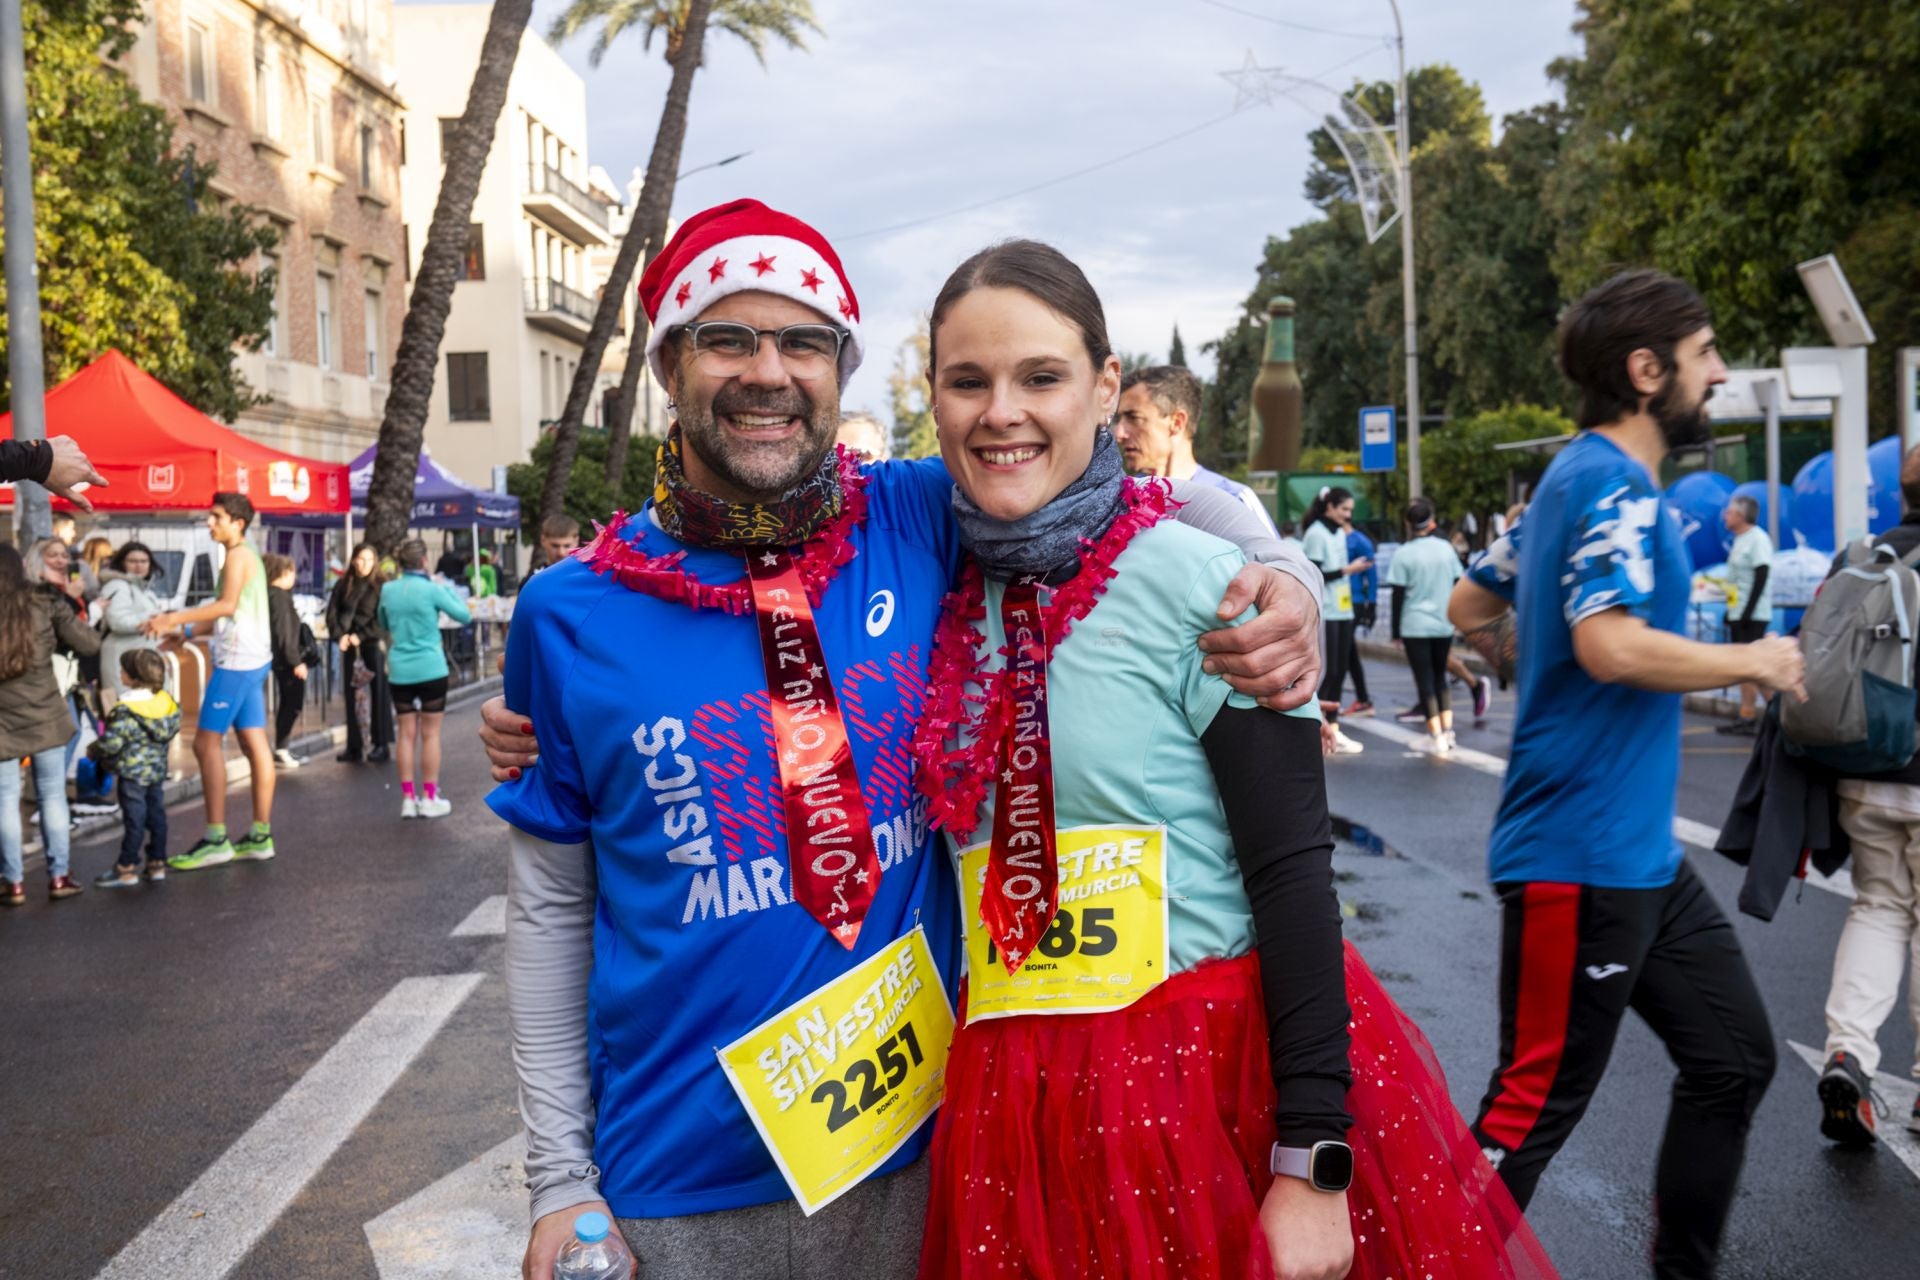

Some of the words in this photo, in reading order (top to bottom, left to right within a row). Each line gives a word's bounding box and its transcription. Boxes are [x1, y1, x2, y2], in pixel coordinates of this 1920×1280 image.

[767, 588, 807, 669] FELIZ
[1011, 609, 1036, 689] FELIZ
[783, 679, 828, 751] AÑO
[1012, 701, 1042, 771] AÑO
[632, 715, 718, 866] ASICS
[798, 760, 858, 877] NUEVO
[1001, 783, 1042, 901] NUEVO
[1058, 871, 1142, 904] MURCIA
[987, 908, 1118, 965] 85
[1025, 963, 1058, 972] BONITA
[757, 1005, 830, 1084] SAN
[769, 943, 918, 1112] SILVESTRE
[873, 975, 923, 1041] MURCIA
[810, 1021, 924, 1134] 2251
[875, 1094, 900, 1116] BONITO
